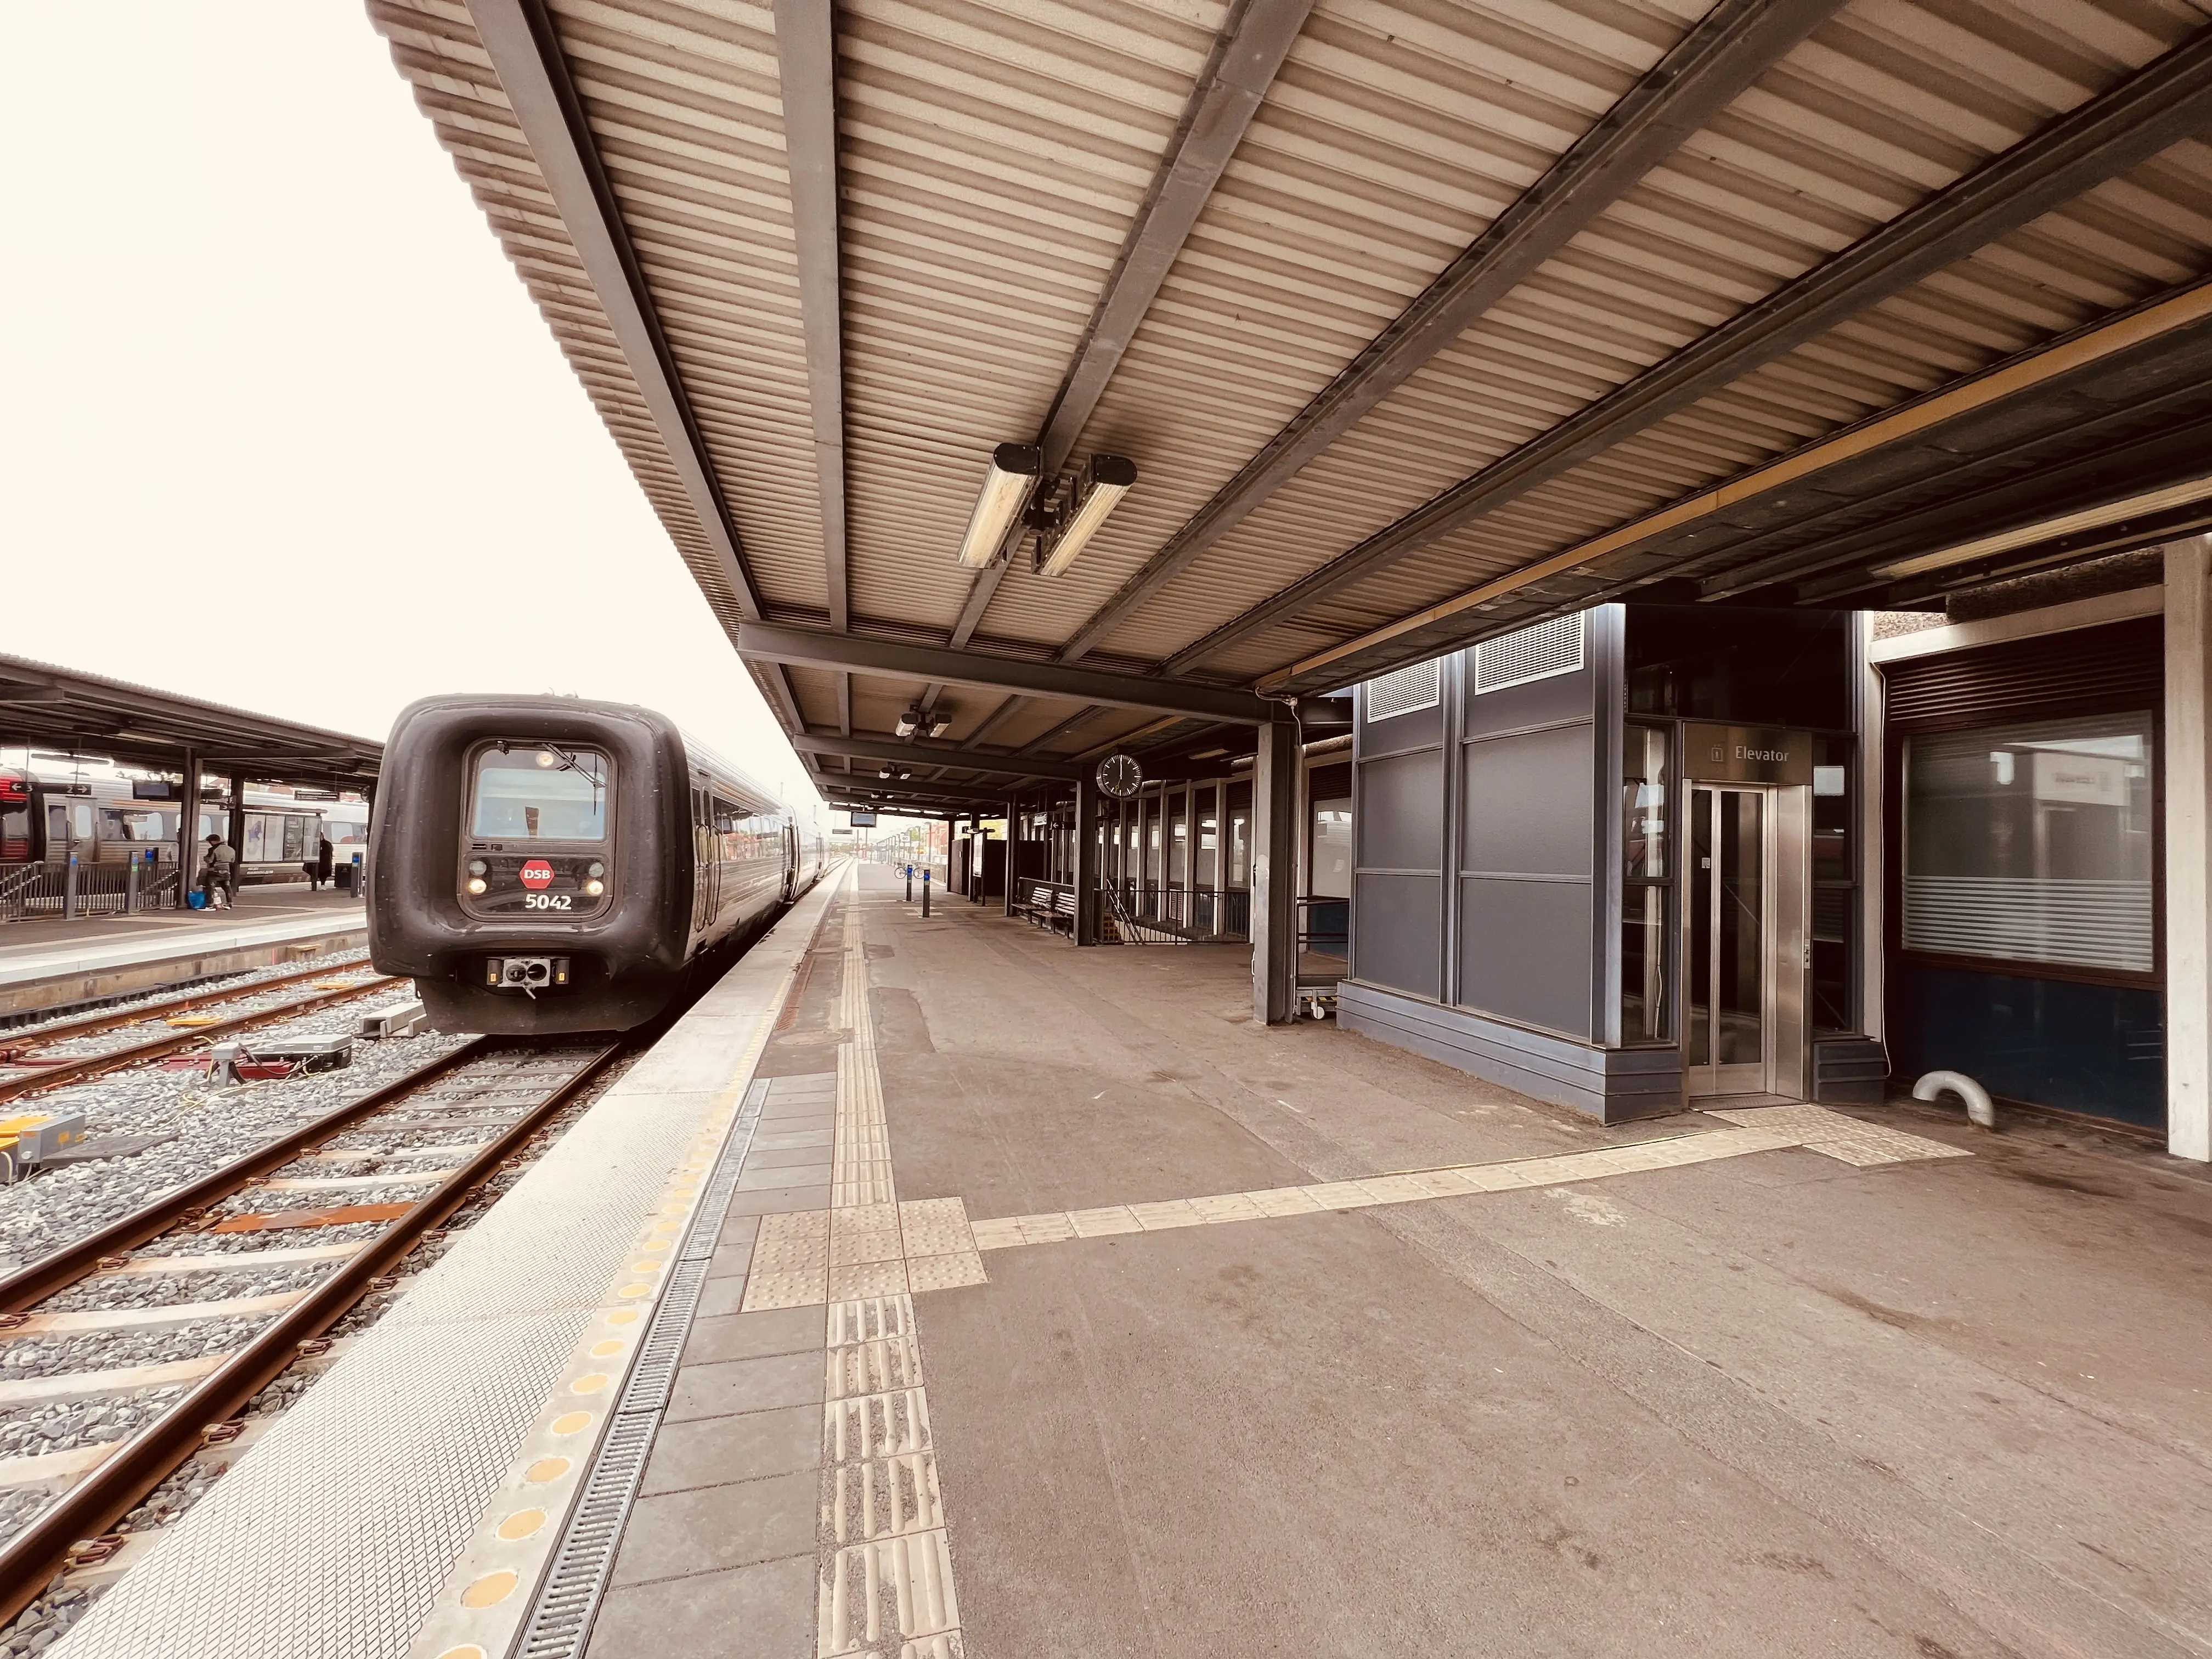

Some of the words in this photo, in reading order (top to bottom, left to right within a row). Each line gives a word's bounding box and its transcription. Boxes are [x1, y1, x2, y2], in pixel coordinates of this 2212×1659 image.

[1735, 746, 1789, 761] Elevator
[524, 870, 551, 879] DSB
[525, 894, 572, 910] 5042
